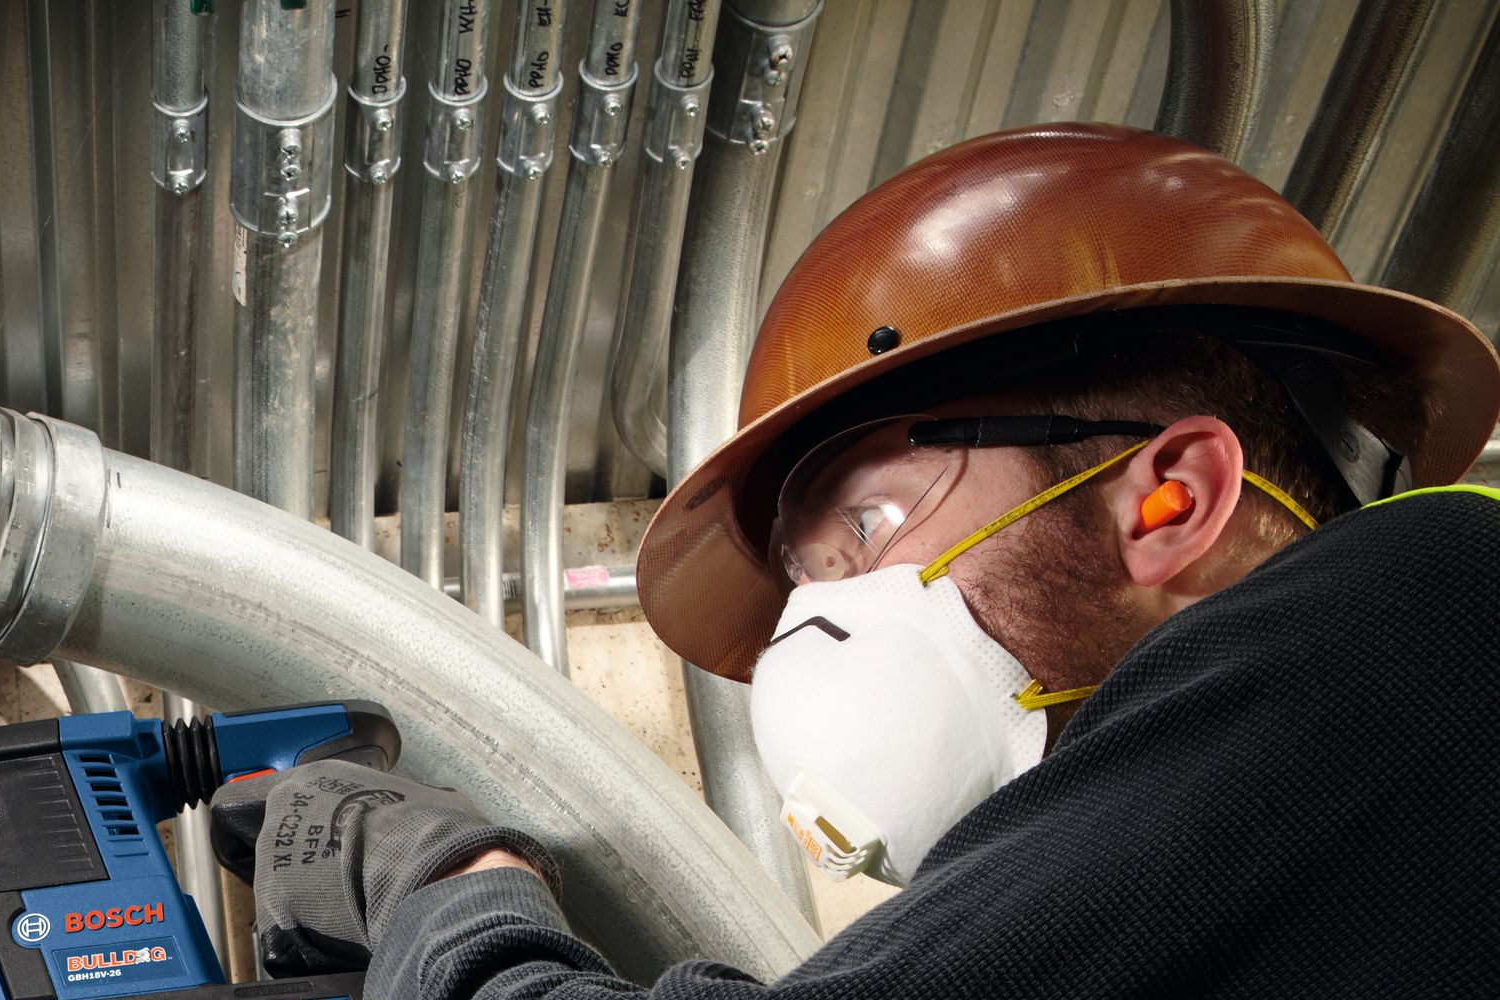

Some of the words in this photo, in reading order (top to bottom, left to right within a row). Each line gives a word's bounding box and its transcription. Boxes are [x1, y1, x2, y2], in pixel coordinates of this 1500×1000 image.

[301, 824, 325, 865] BFN
[272, 852, 293, 872] XL
[65, 902, 165, 933] BOSCH
[66, 946, 167, 973] BULLDG
[67, 968, 122, 983] GBH18V-26
